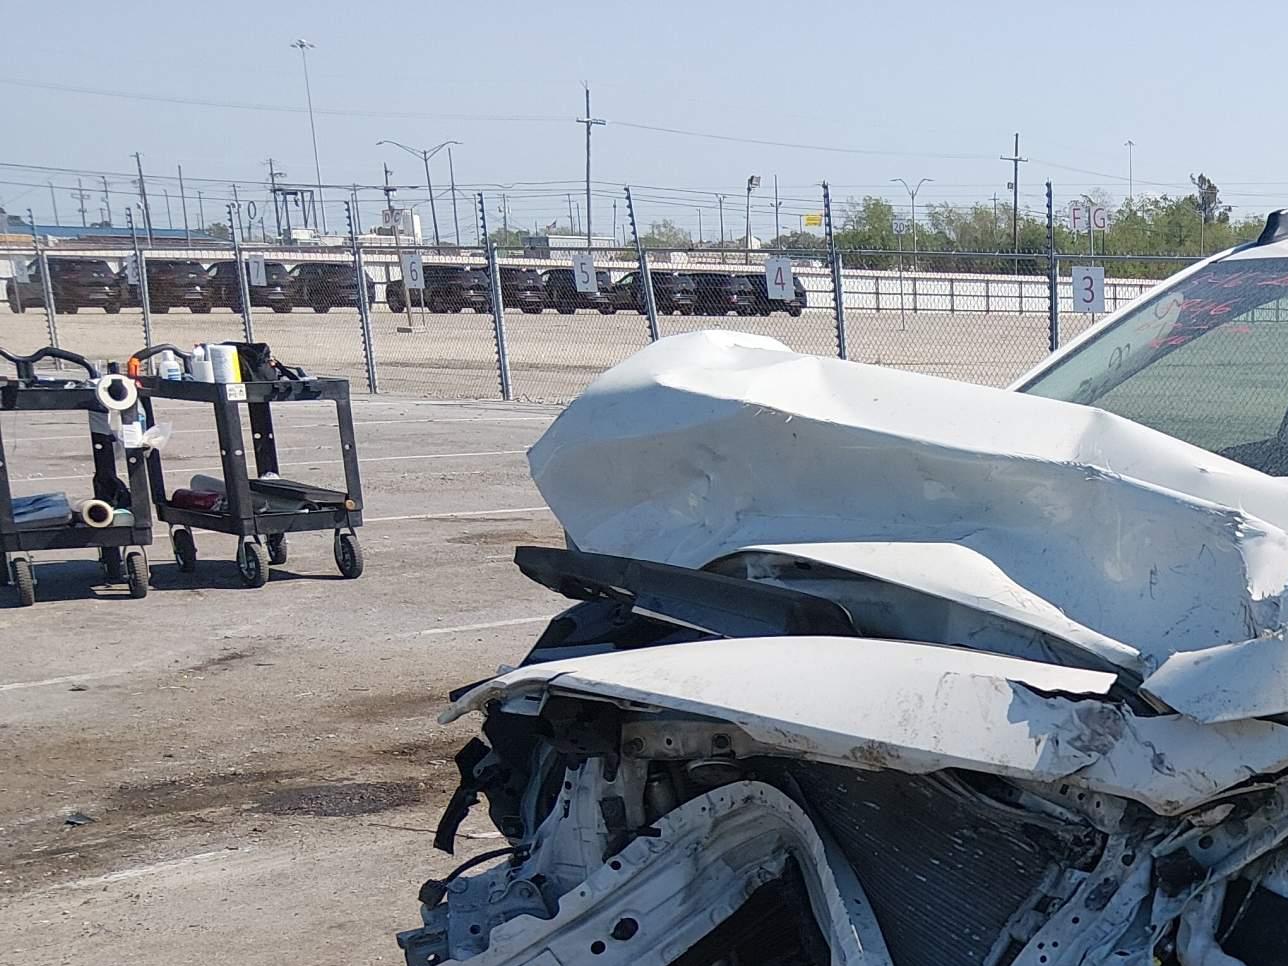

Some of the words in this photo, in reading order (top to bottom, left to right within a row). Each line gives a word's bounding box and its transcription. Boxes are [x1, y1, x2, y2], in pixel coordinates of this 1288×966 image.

[1072, 207, 1081, 229] F
[1093, 207, 1106, 229] G
[409, 261, 418, 282] 6
[579, 262, 590, 284] 5
[774, 266, 786, 291] 4
[1082, 275, 1095, 304] 3
